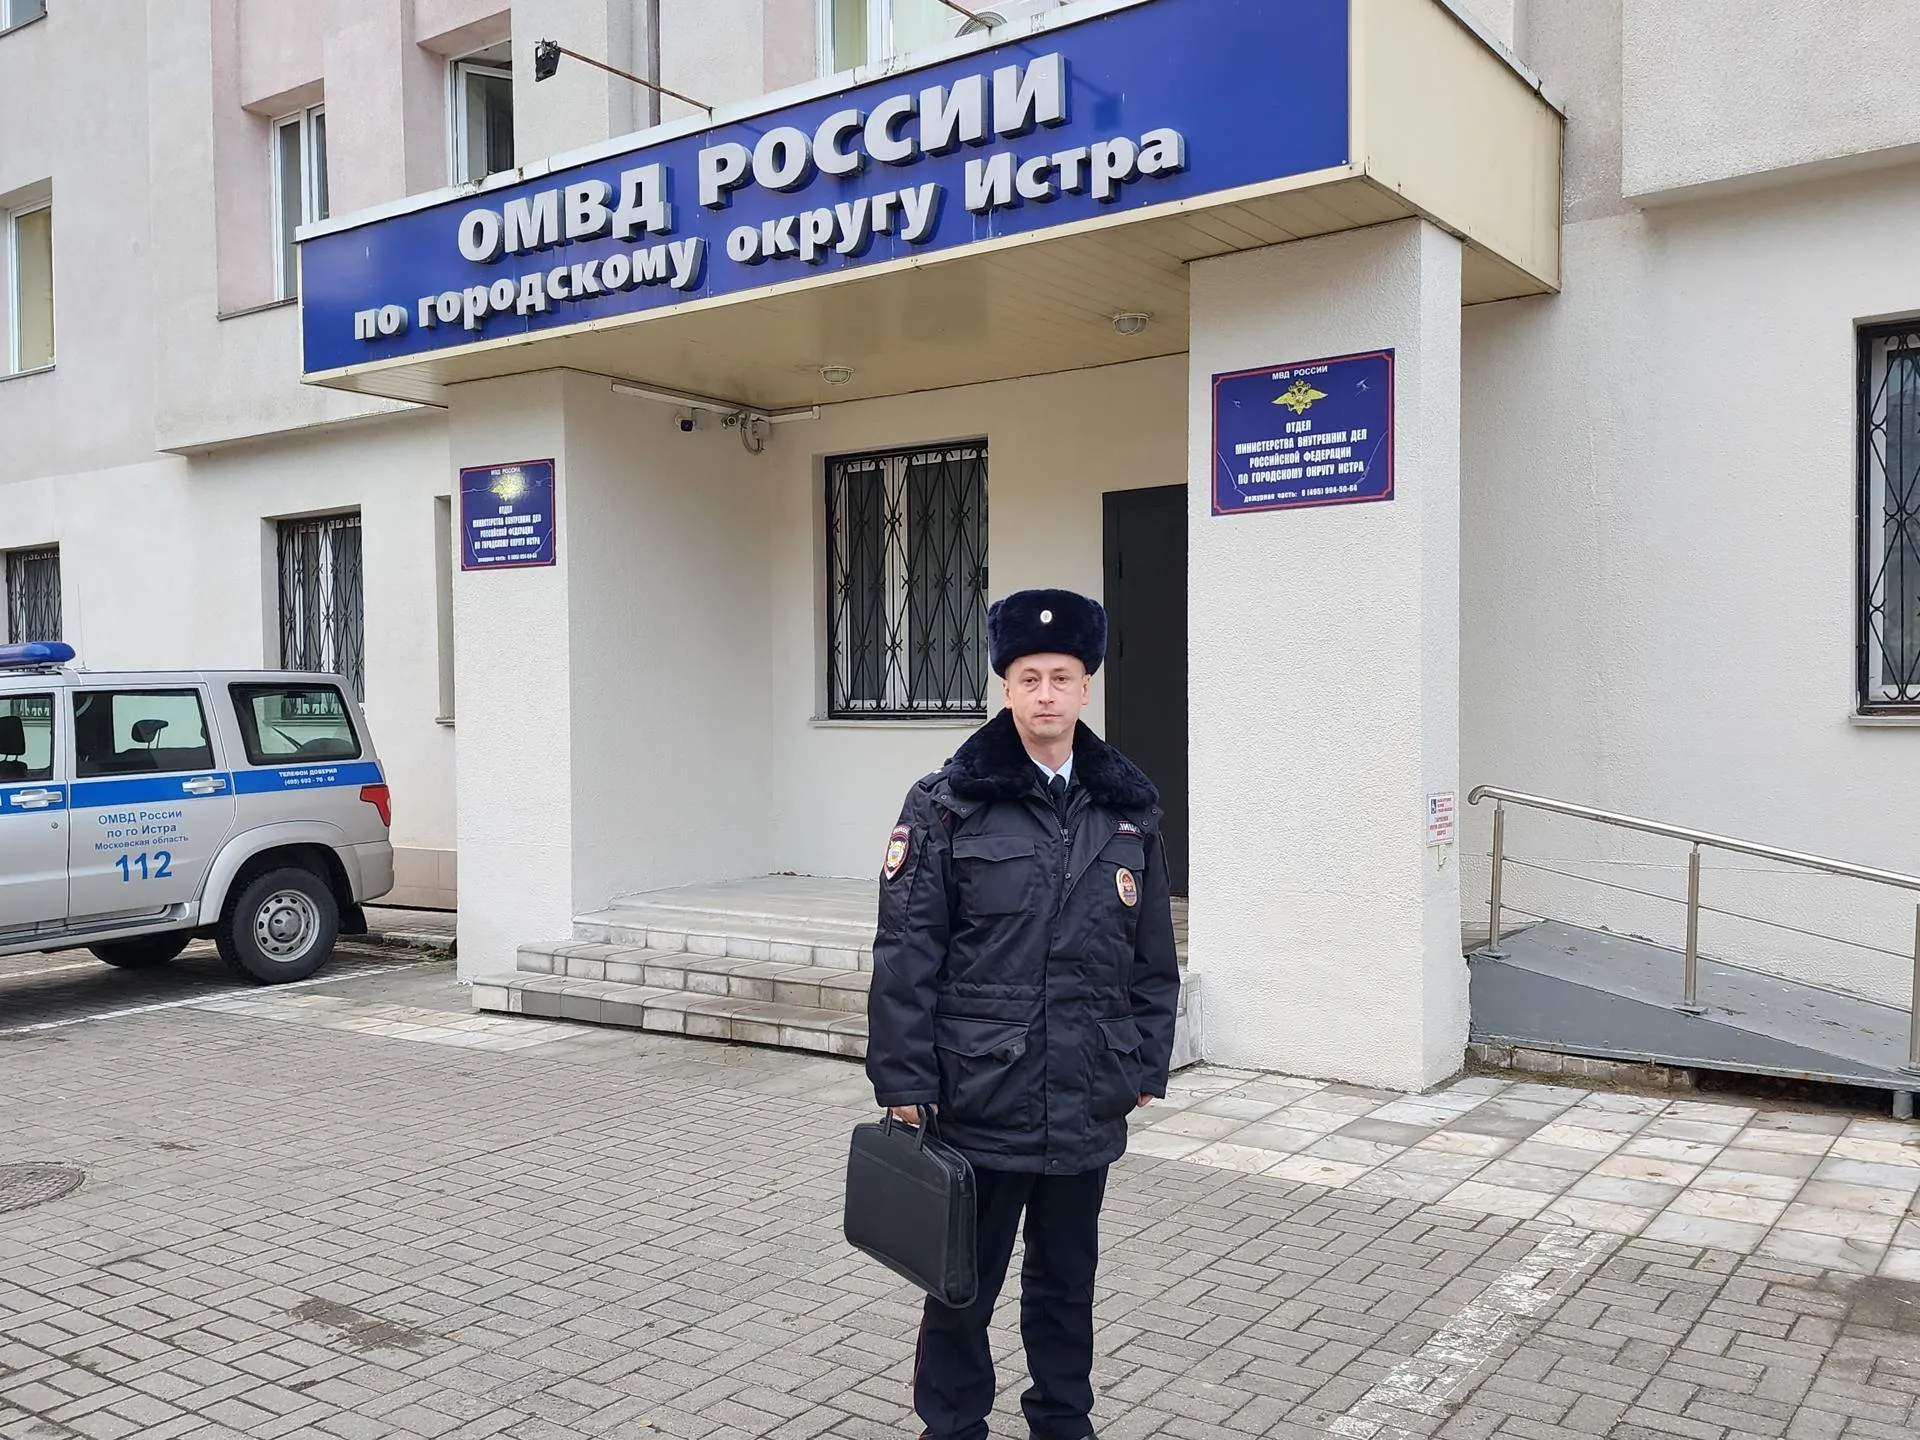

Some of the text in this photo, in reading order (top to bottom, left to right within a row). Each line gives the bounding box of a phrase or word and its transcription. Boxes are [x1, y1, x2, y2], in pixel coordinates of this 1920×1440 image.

[458, 52, 1067, 265] ОМВД РОССИИ
[354, 128, 1186, 342] по городскому округу Истра
[1272, 365, 1328, 381] МВД РОССИИ
[1285, 420, 1312, 433] ОТДЕЛ
[1235, 428, 1367, 455] МИНИСТЕРСТВА ВНУТРЕННИХ ДЕЛ
[1249, 447, 1352, 469] РОССИЙСКОЙ ФЕДЕРАЦИИ
[1238, 461, 1364, 485] ПО ГОРОДСКОМУ ОКРУГУ ИСТРА
[1277, 491, 1298, 500] часть:
[278, 768, 338, 778] ТЕЛЕФОН ДОВЕРИЯ
[98, 810, 183, 825] ОМВД России
[107, 824, 177, 839] по го Истра
[95, 834, 189, 851] Московская область
[115, 850, 173, 882] 112
